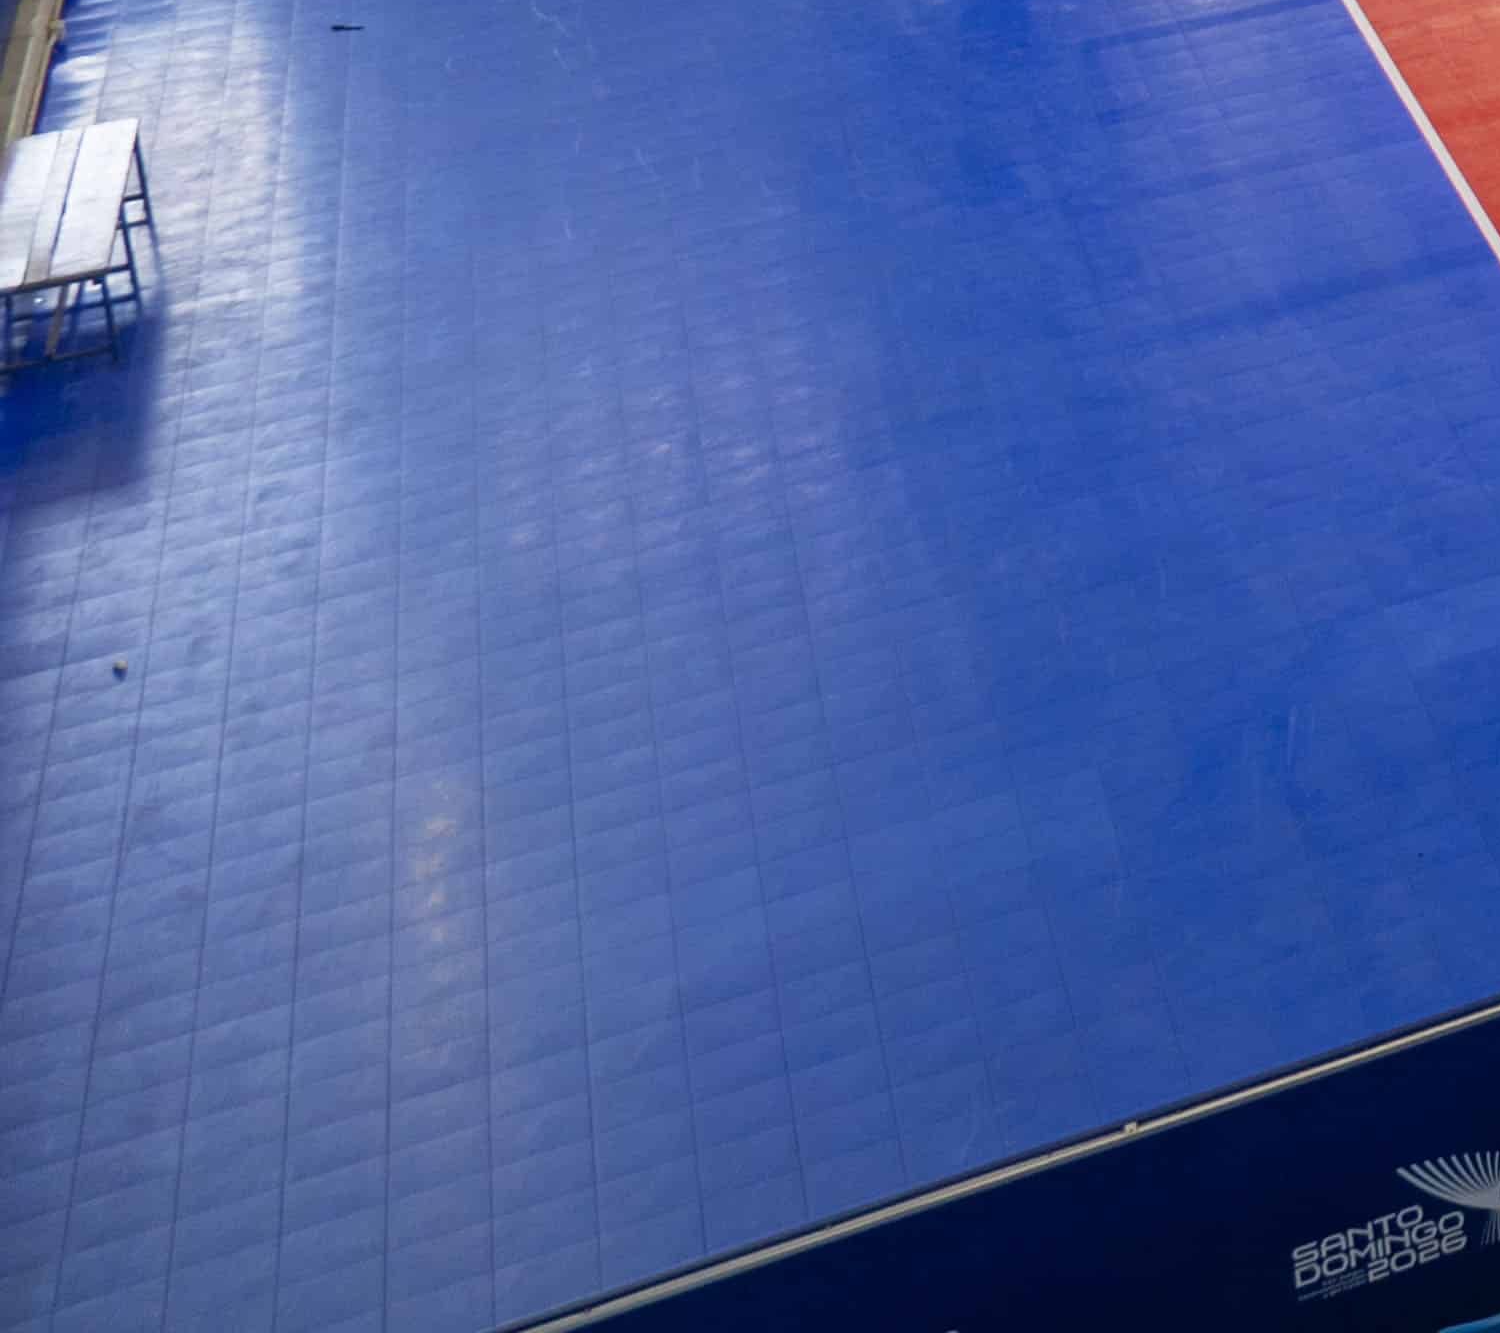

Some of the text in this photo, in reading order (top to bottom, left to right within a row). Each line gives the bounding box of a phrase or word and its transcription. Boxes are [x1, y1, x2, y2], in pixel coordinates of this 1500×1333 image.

[1292, 1204, 1423, 1266] SANTO
[1295, 1211, 1465, 1288] DOMINGO
[1367, 1230, 1468, 1282] 2026
